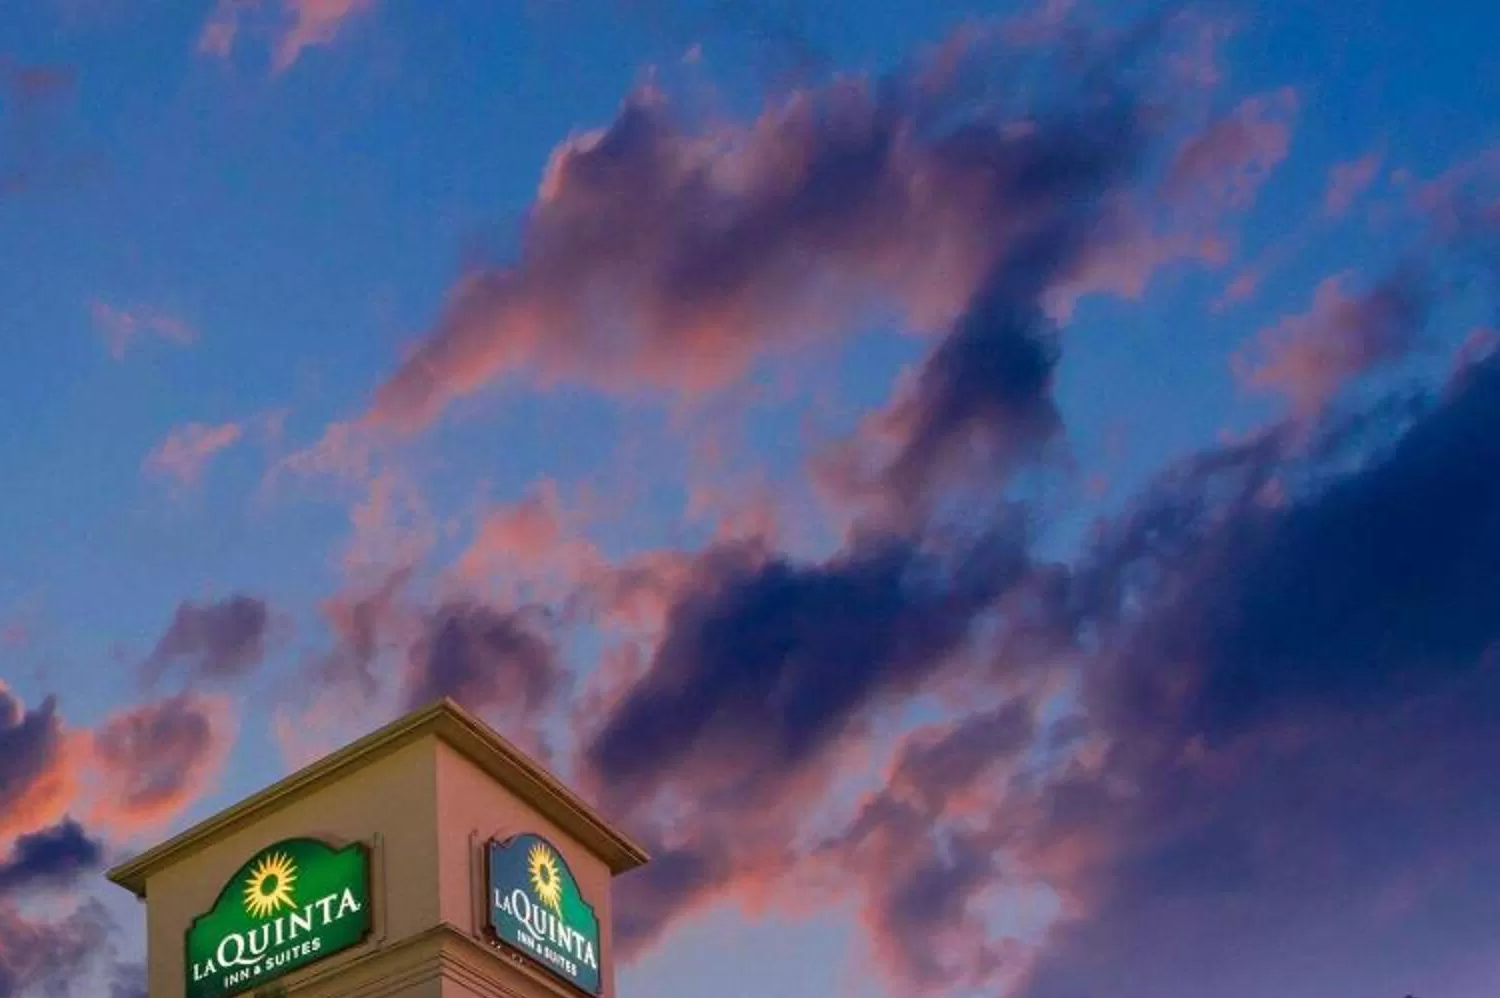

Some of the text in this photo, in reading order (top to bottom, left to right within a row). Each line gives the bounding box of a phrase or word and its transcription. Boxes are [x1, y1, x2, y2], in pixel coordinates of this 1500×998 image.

[192, 887, 362, 982] LA QUINTA
[223, 968, 251, 988] INN
[265, 936, 322, 972] SUITES
[494, 888, 597, 970] LA QUINTA
[517, 929, 535, 950] INN
[543, 946, 578, 977] SUITES
